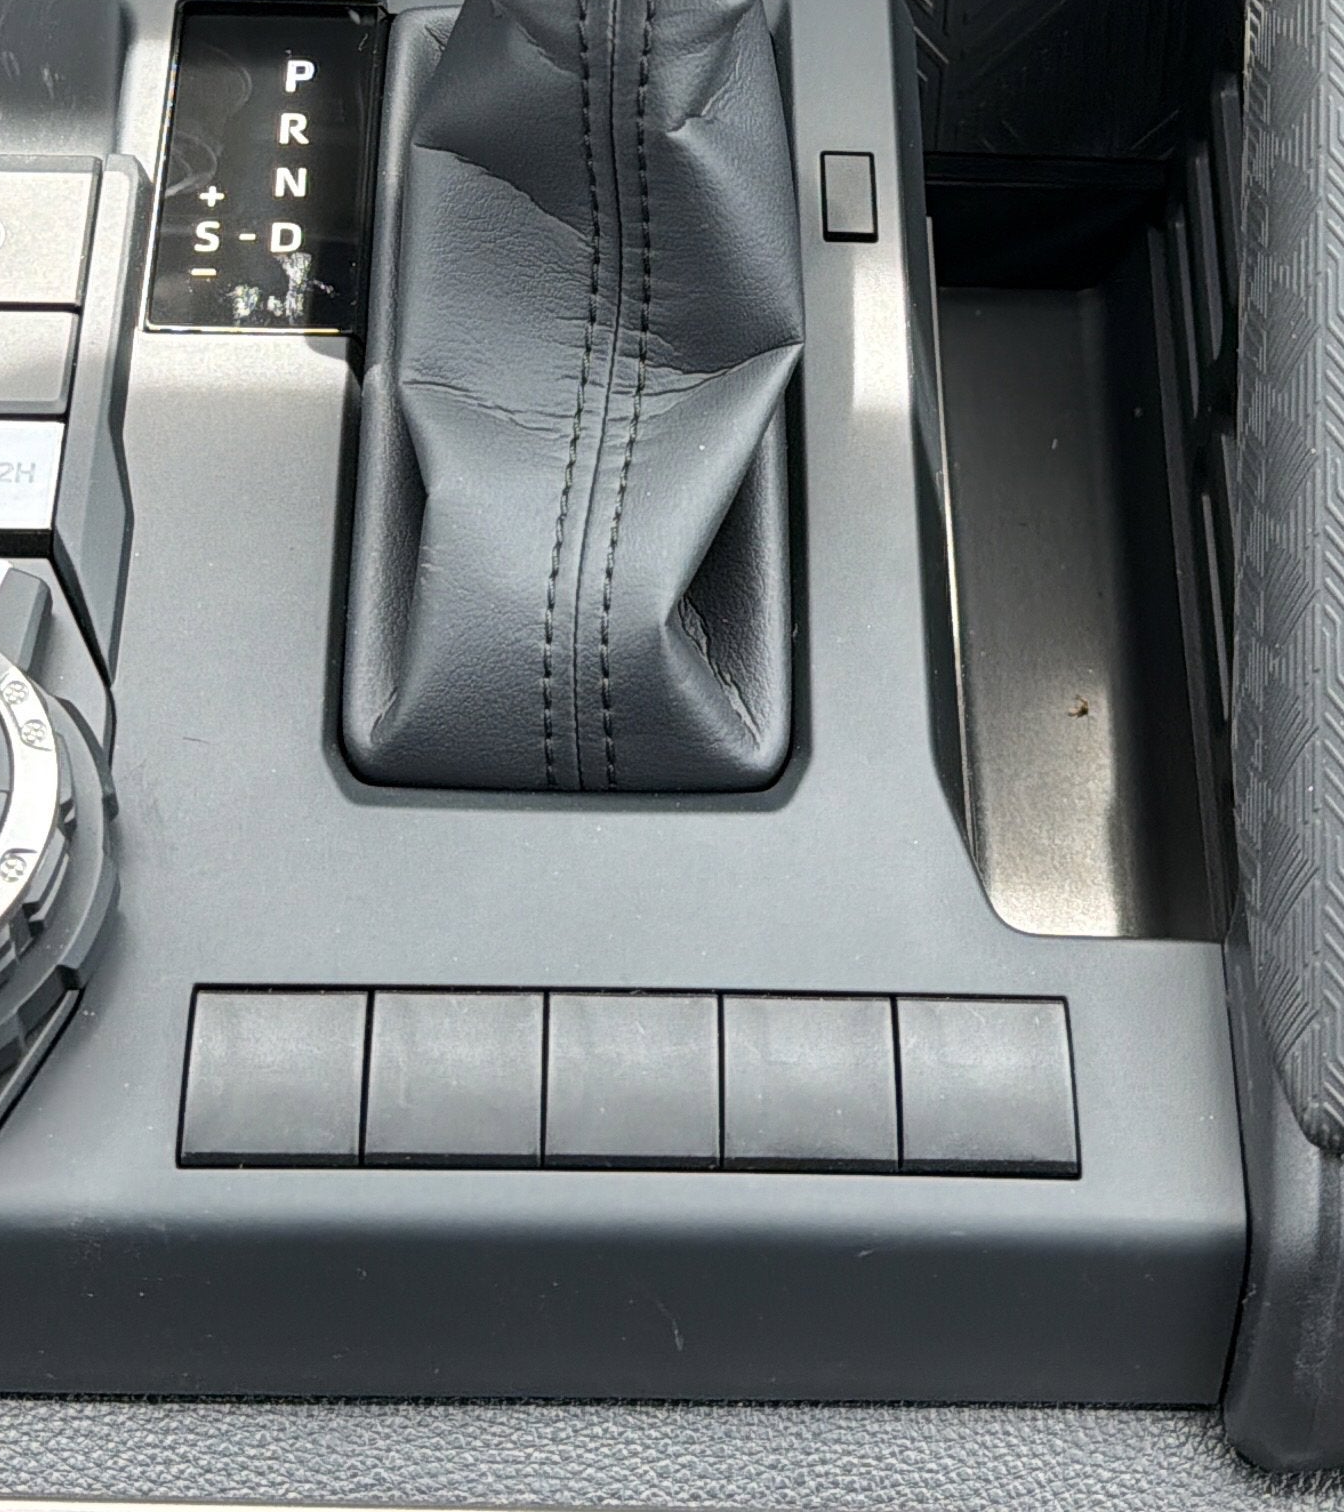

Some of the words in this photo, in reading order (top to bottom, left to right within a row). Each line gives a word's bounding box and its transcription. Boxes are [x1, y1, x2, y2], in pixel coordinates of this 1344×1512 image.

[283, 59, 315, 93] P
[278, 112, 310, 145] R
[273, 166, 308, 198] N
[193, 220, 222, 253] S
[269, 221, 303, 254] D
